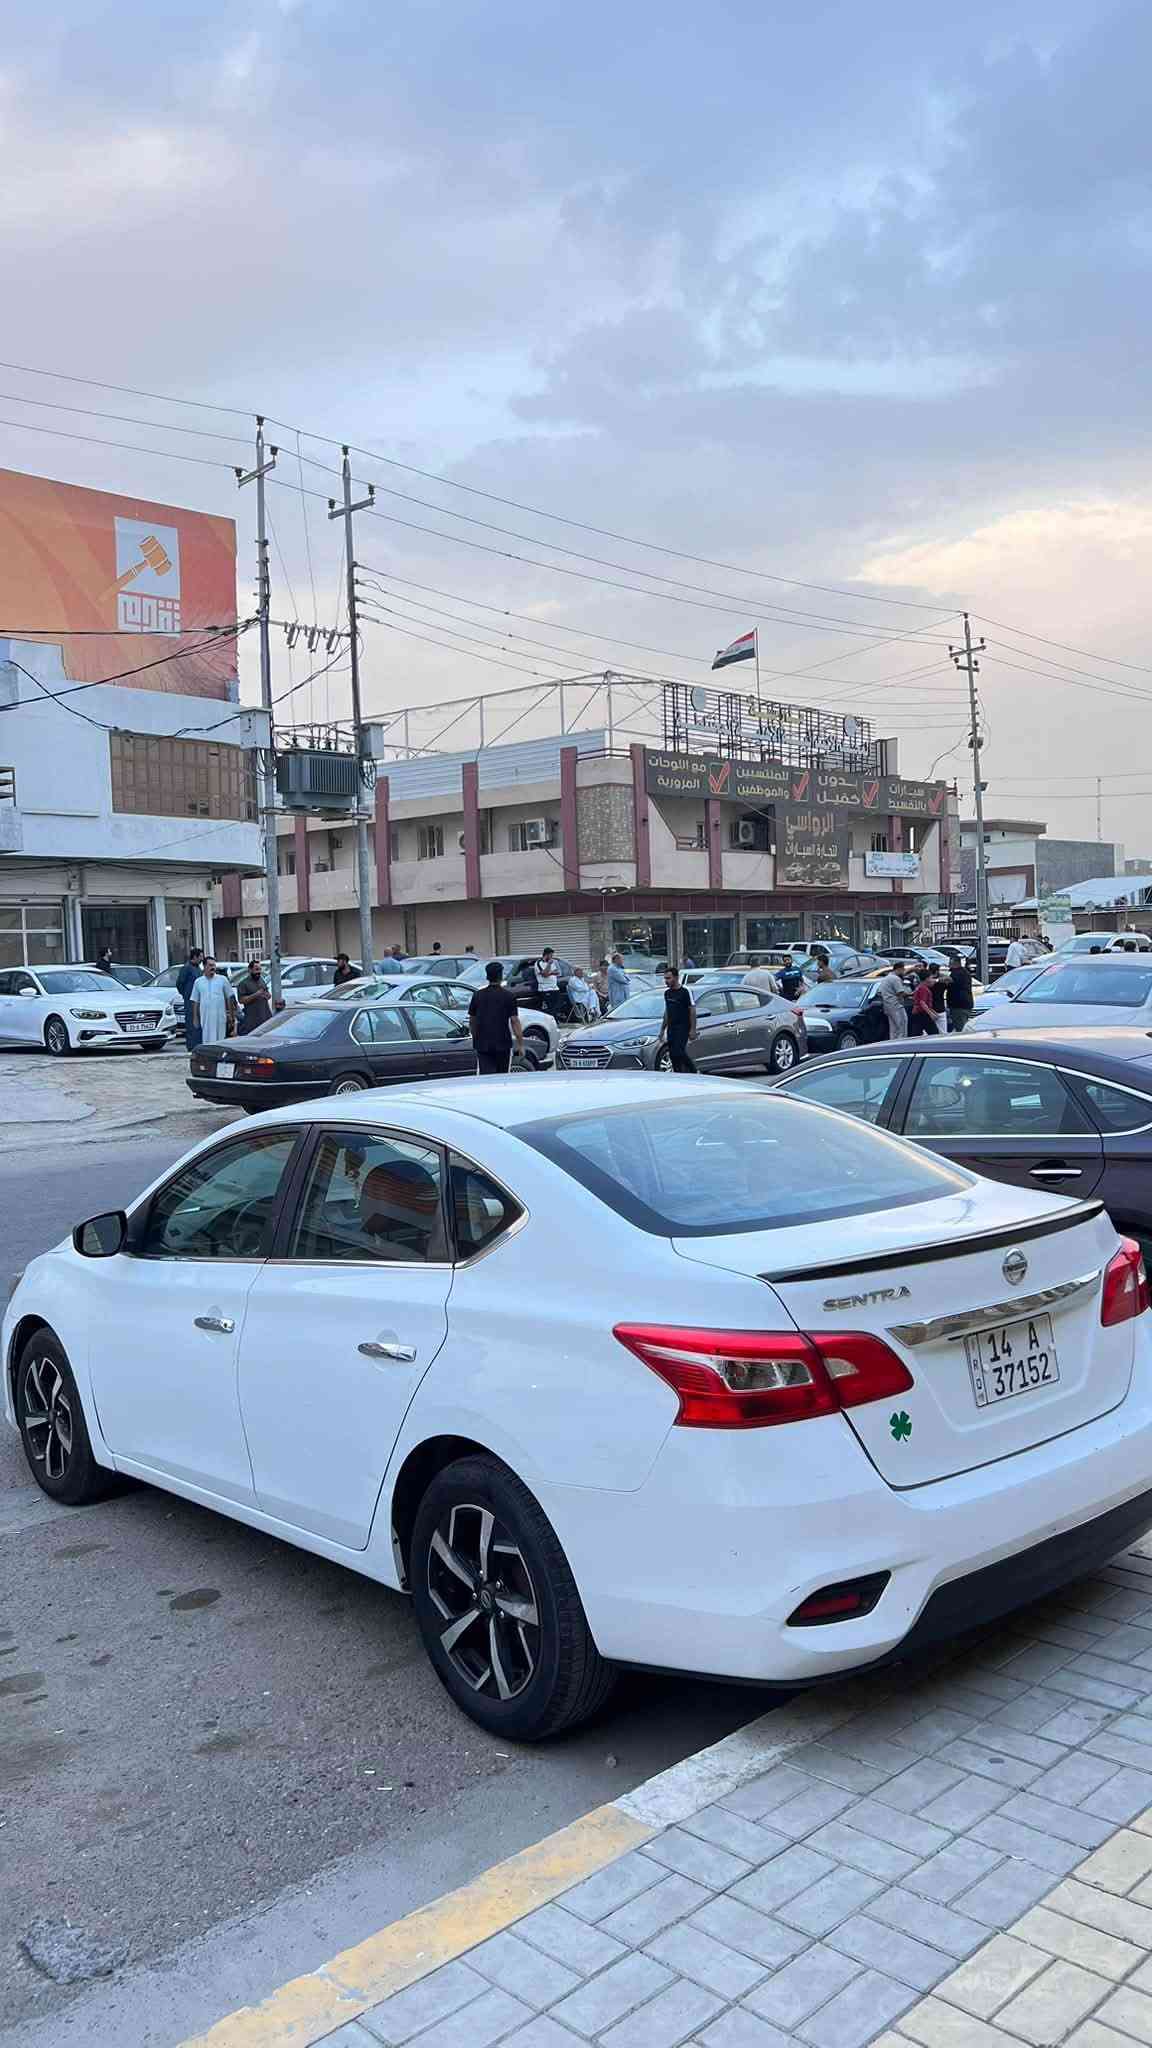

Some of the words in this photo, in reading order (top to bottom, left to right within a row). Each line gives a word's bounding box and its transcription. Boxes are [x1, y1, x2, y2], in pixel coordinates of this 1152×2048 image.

[648, 755, 689, 772] اللوحات
[736, 765, 790, 781] للمنتسبين
[657, 774, 701, 790] المرورية
[737, 783, 790, 799] والموظفين
[888, 797, 927, 811] بالتقسيط
[822, 1286, 912, 1312] SENTRA
[988, 1328, 1012, 1362] 14
[1029, 1321, 1040, 1351] A
[992, 1352, 1052, 1396] 37152
